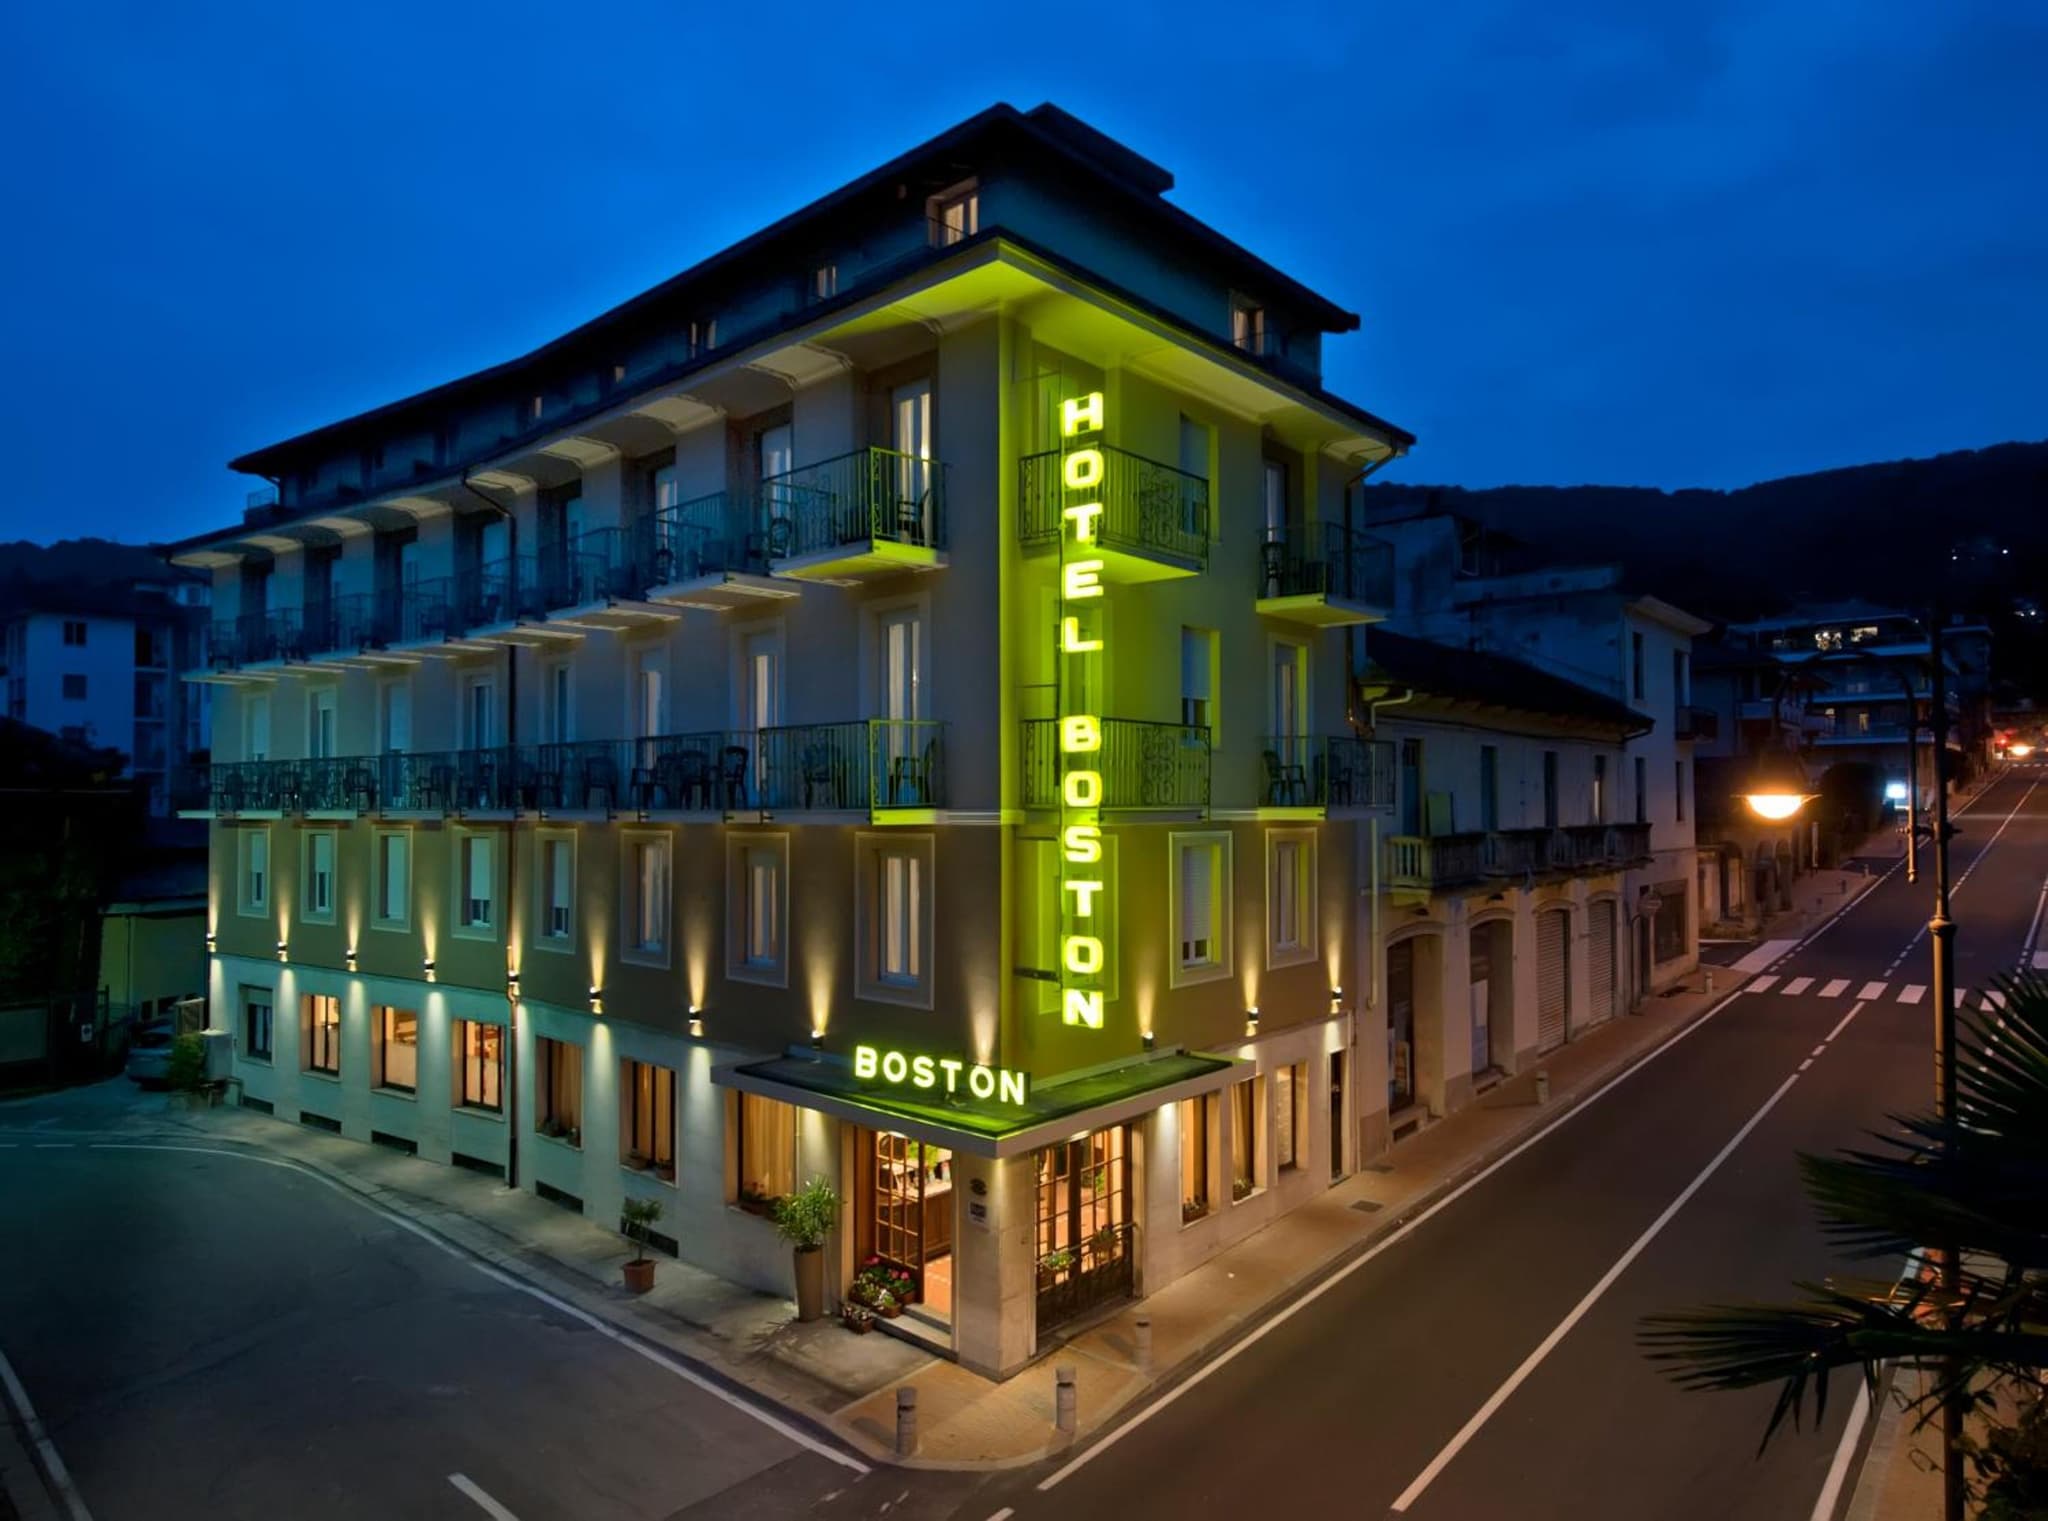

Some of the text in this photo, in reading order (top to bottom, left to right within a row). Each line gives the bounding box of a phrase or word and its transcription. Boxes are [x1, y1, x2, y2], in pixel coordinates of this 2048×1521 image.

[1060, 391, 1104, 1029] HOTEL BOSTON
[854, 1045, 1026, 1106] BOSTON
